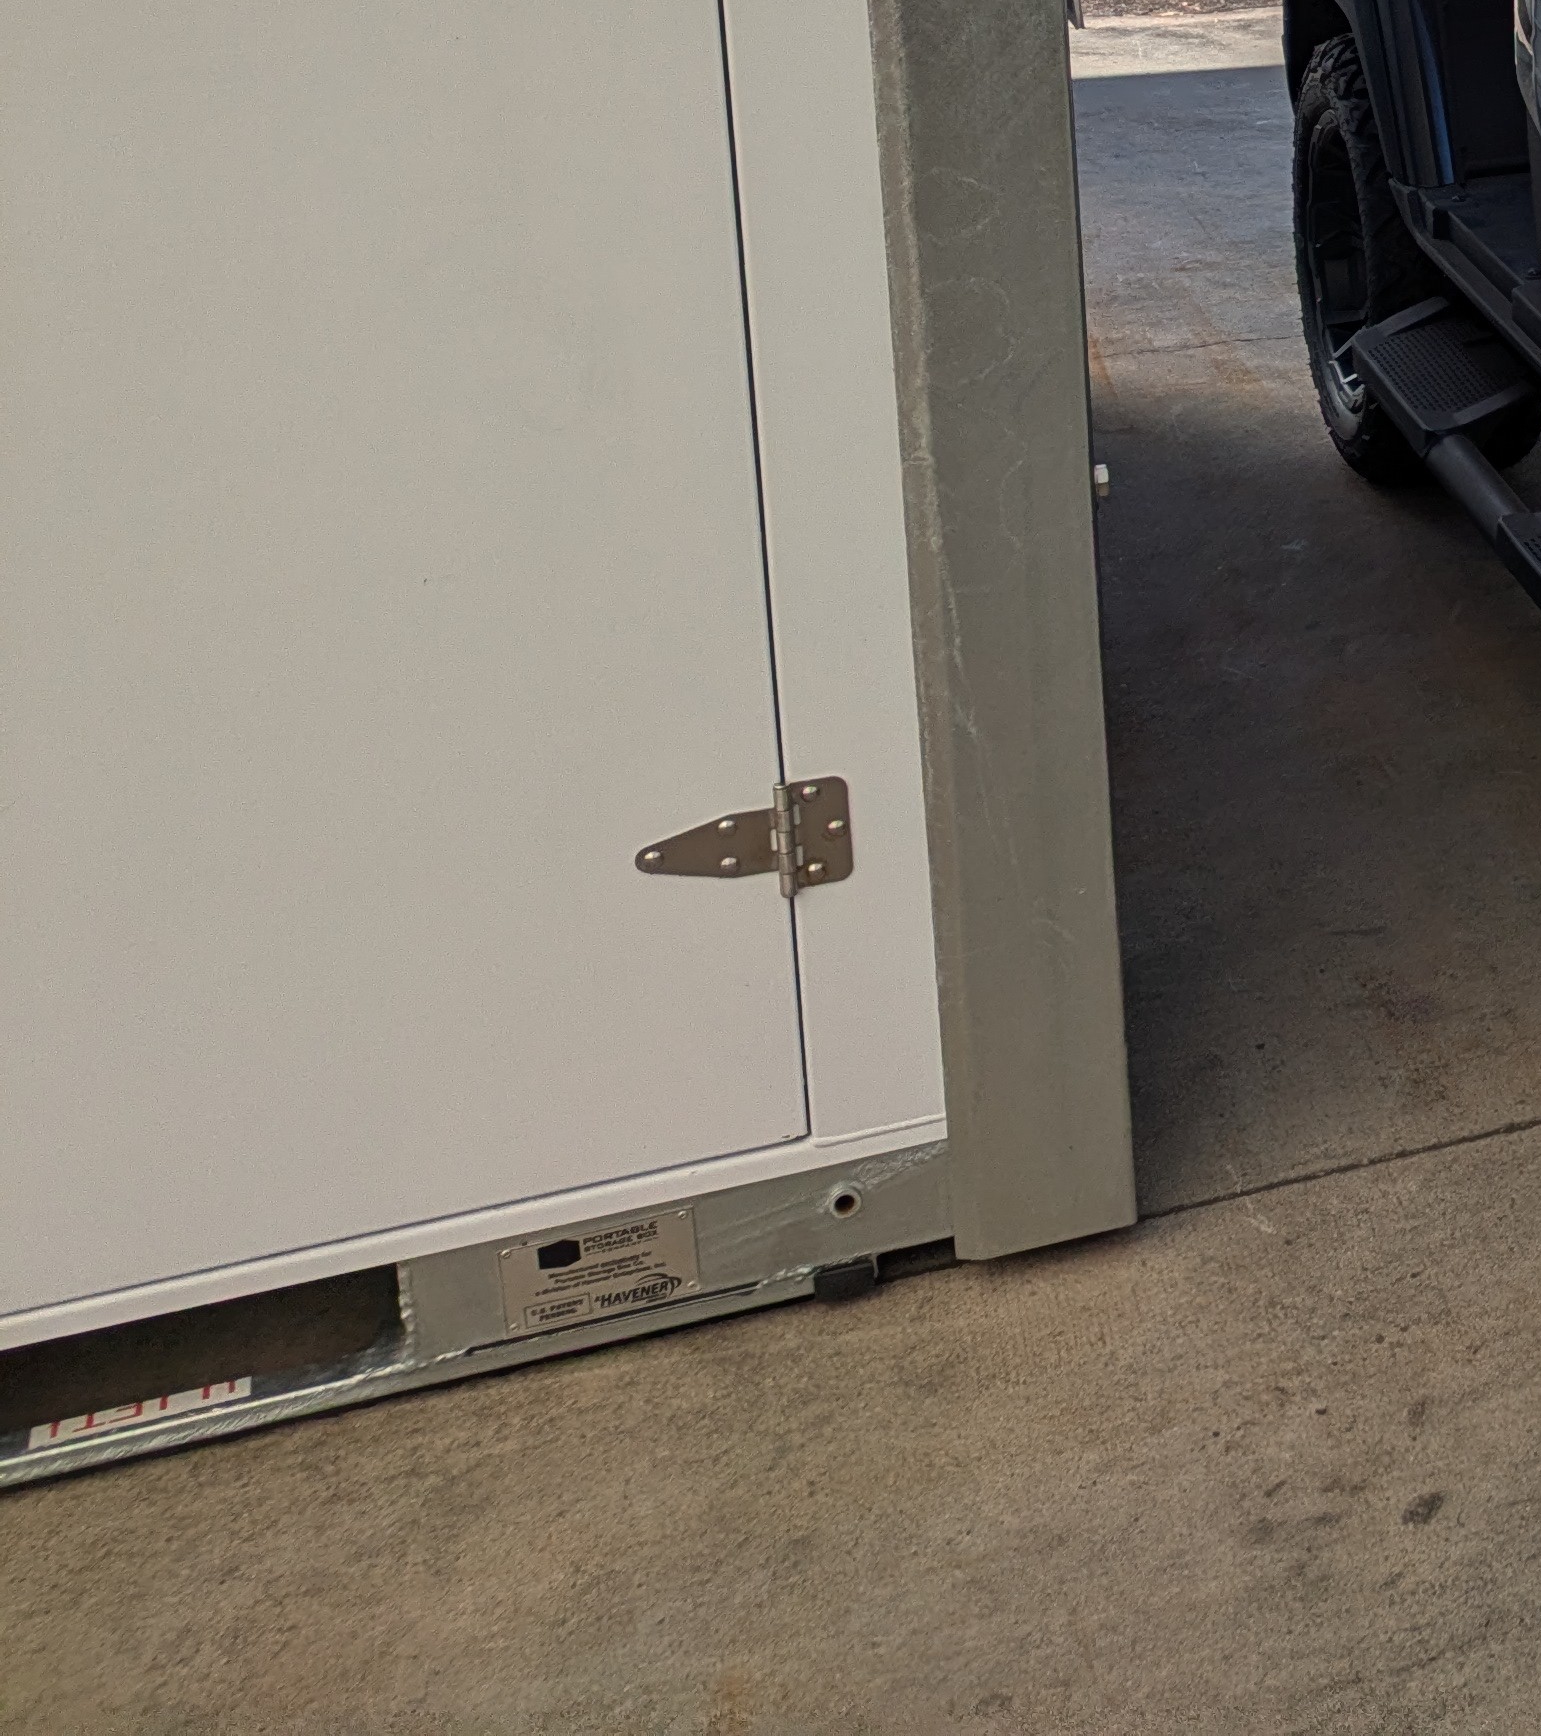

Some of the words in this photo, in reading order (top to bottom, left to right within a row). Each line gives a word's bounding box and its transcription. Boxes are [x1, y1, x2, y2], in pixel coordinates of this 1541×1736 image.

[583, 1220, 658, 1246] PORTABLE
[583, 1236, 634, 1253] STORAGE
[600, 1280, 668, 1308] HAVENER
